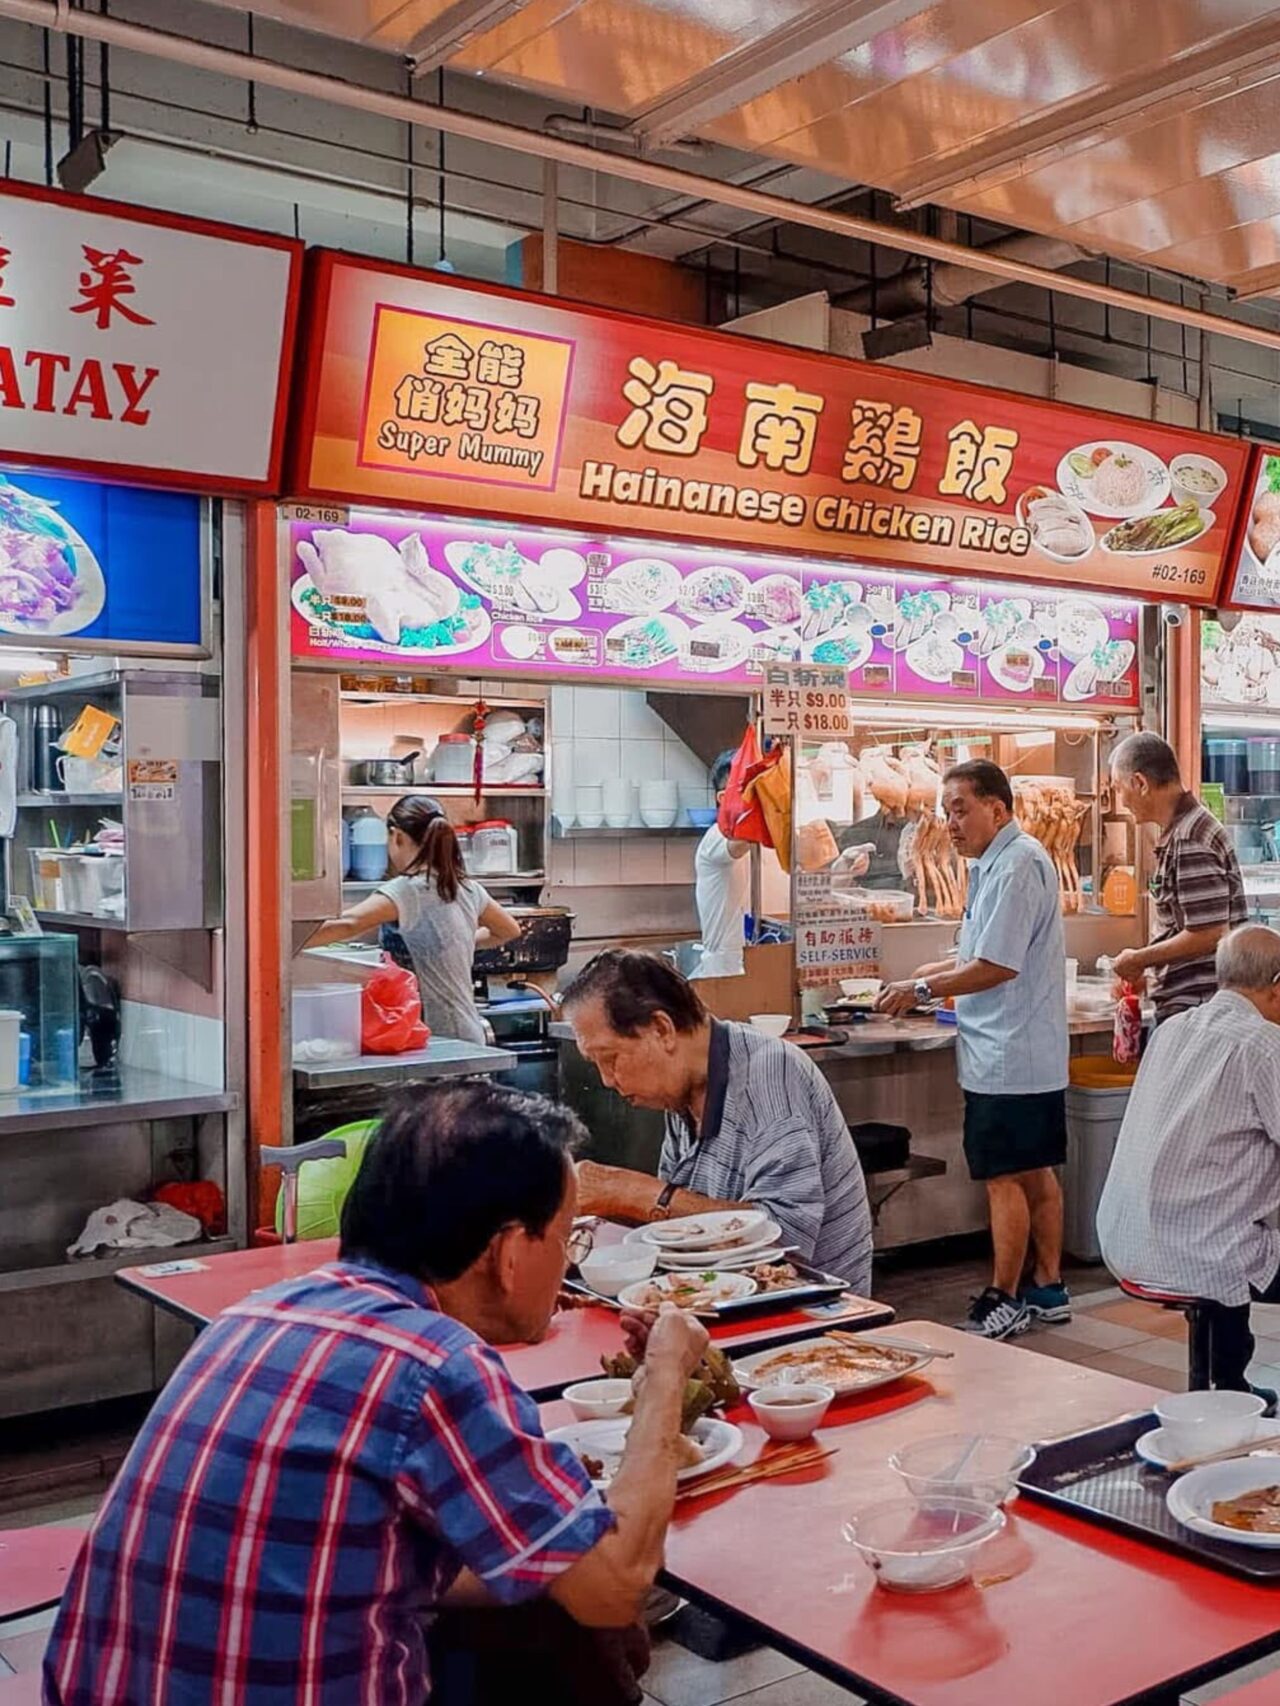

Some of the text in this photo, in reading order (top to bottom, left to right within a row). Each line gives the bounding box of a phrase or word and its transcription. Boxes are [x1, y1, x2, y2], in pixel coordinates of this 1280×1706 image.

[424, 333, 525, 388] 全能
[394, 374, 540, 438] 俏妈妈
[378, 420, 544, 477] Super Mummy
[295, 507, 340, 523] 02-169
[580, 460, 1030, 556] Hainanese Chicken Rice
[1152, 564, 1206, 584] #02-169
[770, 688, 846, 708] 半只 $9.00
[771, 712, 849, 730] 一只 $18.00
[800, 947, 879, 963] SELF-SERVICE
